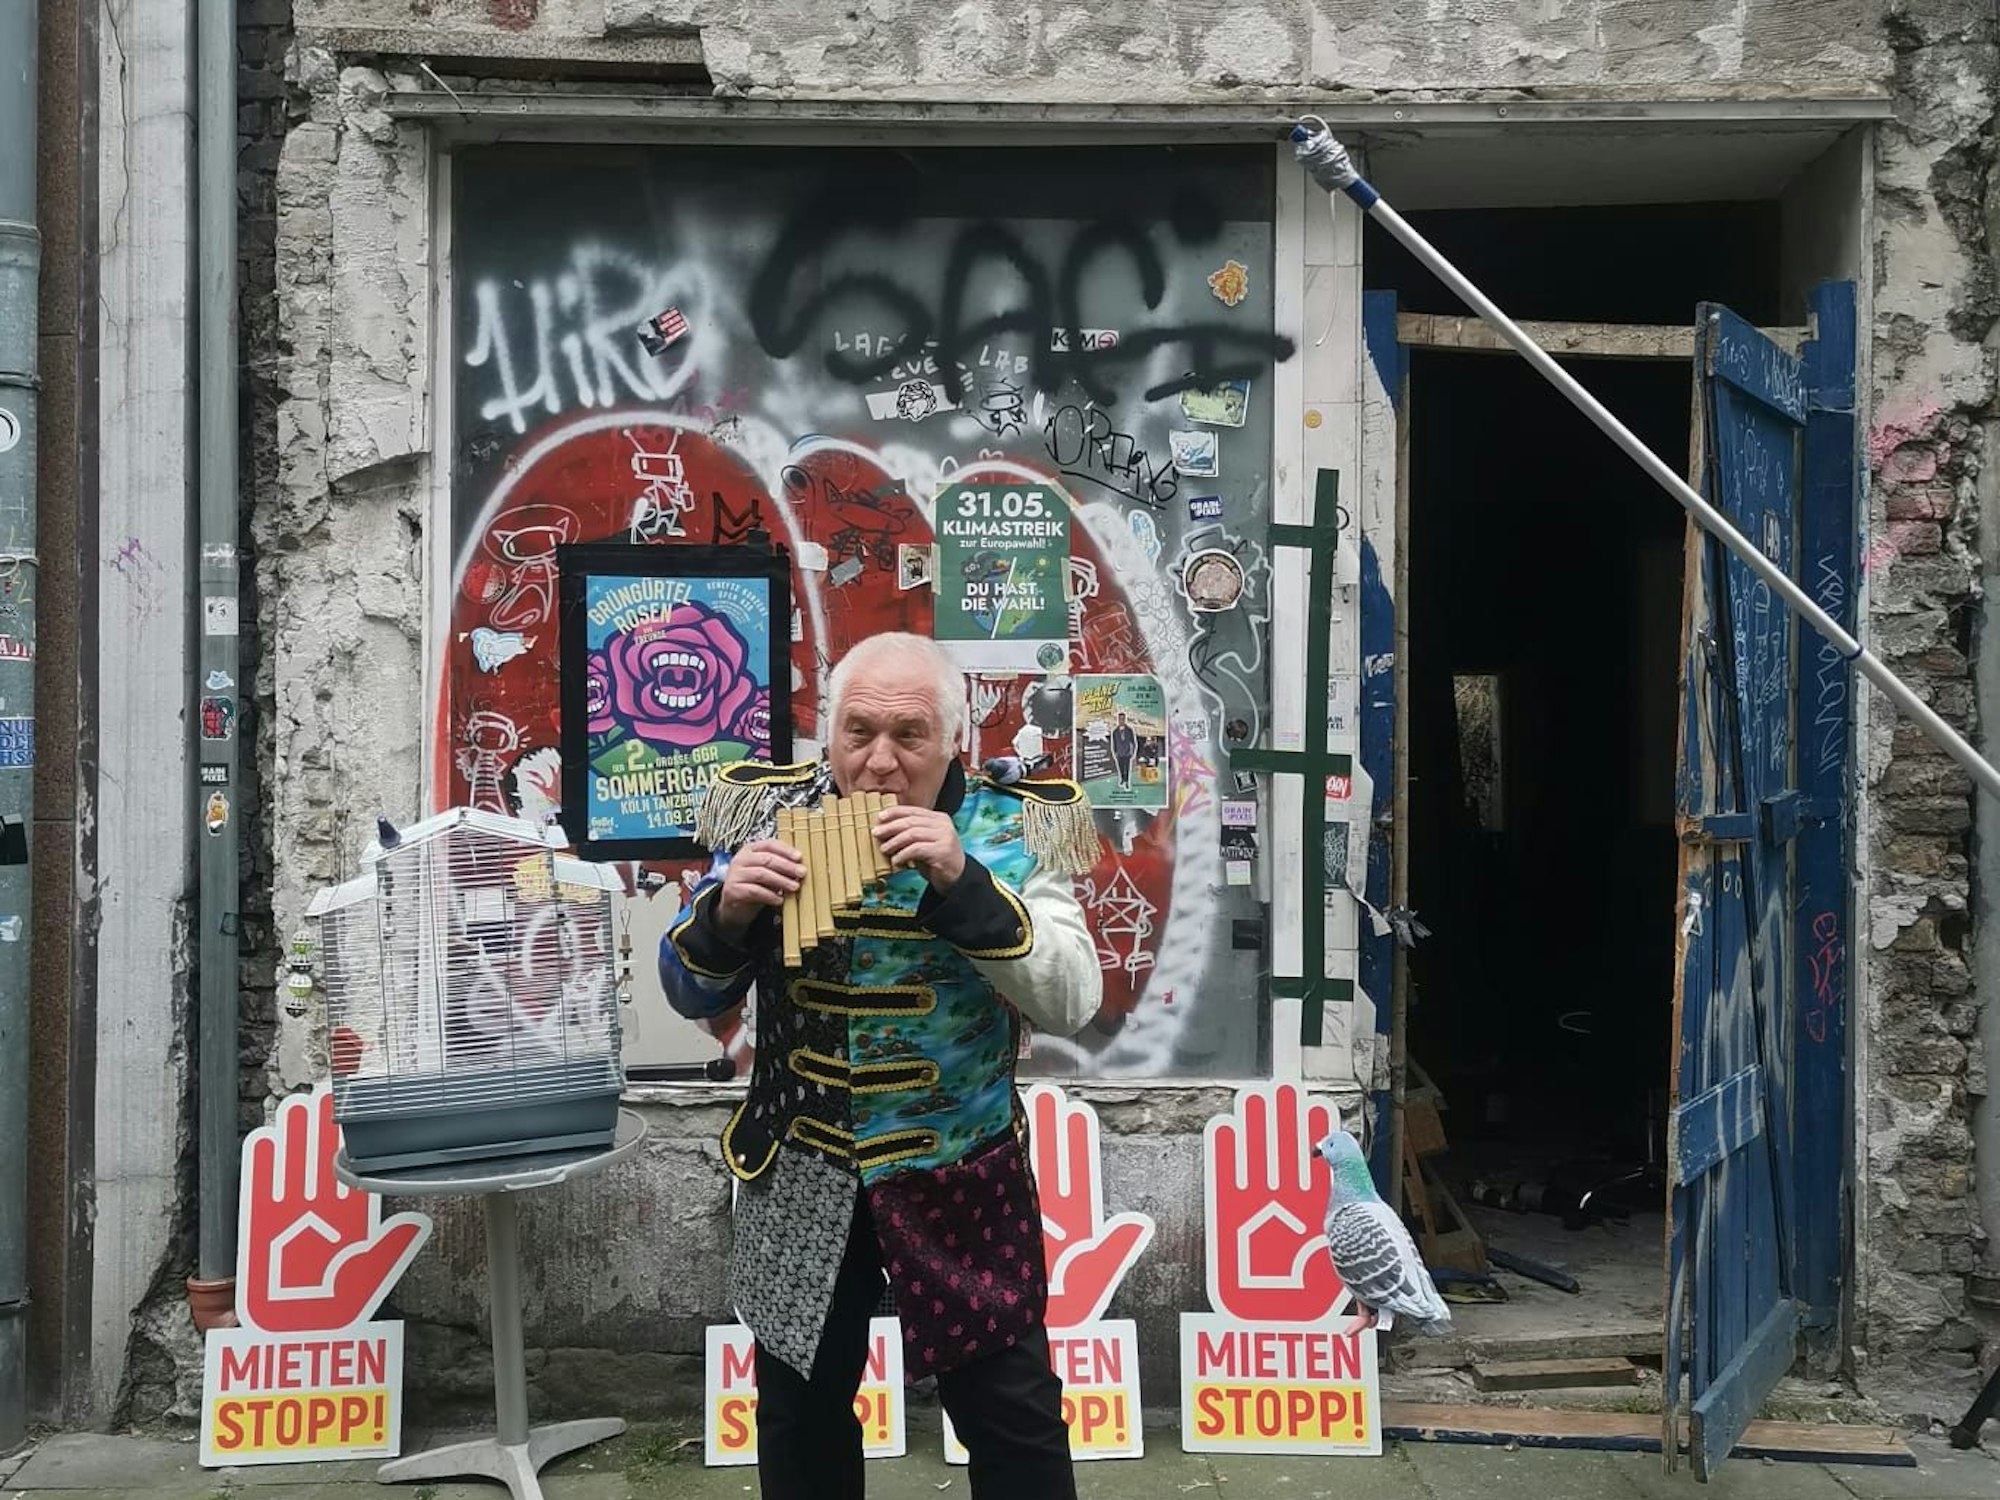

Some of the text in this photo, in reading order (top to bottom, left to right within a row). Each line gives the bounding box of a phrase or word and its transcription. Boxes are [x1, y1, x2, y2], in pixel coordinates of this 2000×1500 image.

[957, 491, 1053, 518] 31.05.
[943, 520, 1065, 537] KLIMASTREIK
[960, 539, 977, 548] zur
[587, 577, 693, 626] GRÜNGÜRTEL
[961, 597, 1045, 610] DIE WAHL!
[967, 583, 989, 596] DU
[613, 602, 673, 636] ROSEN
[625, 738, 654, 772] 2.
[620, 799, 649, 816] KÖLN
[220, 1338, 386, 1391] MIETEN
[1196, 1331, 1361, 1380] MIETEN
[216, 1394, 384, 1449] STOPP!
[1197, 1387, 1364, 1439] STOPP!
